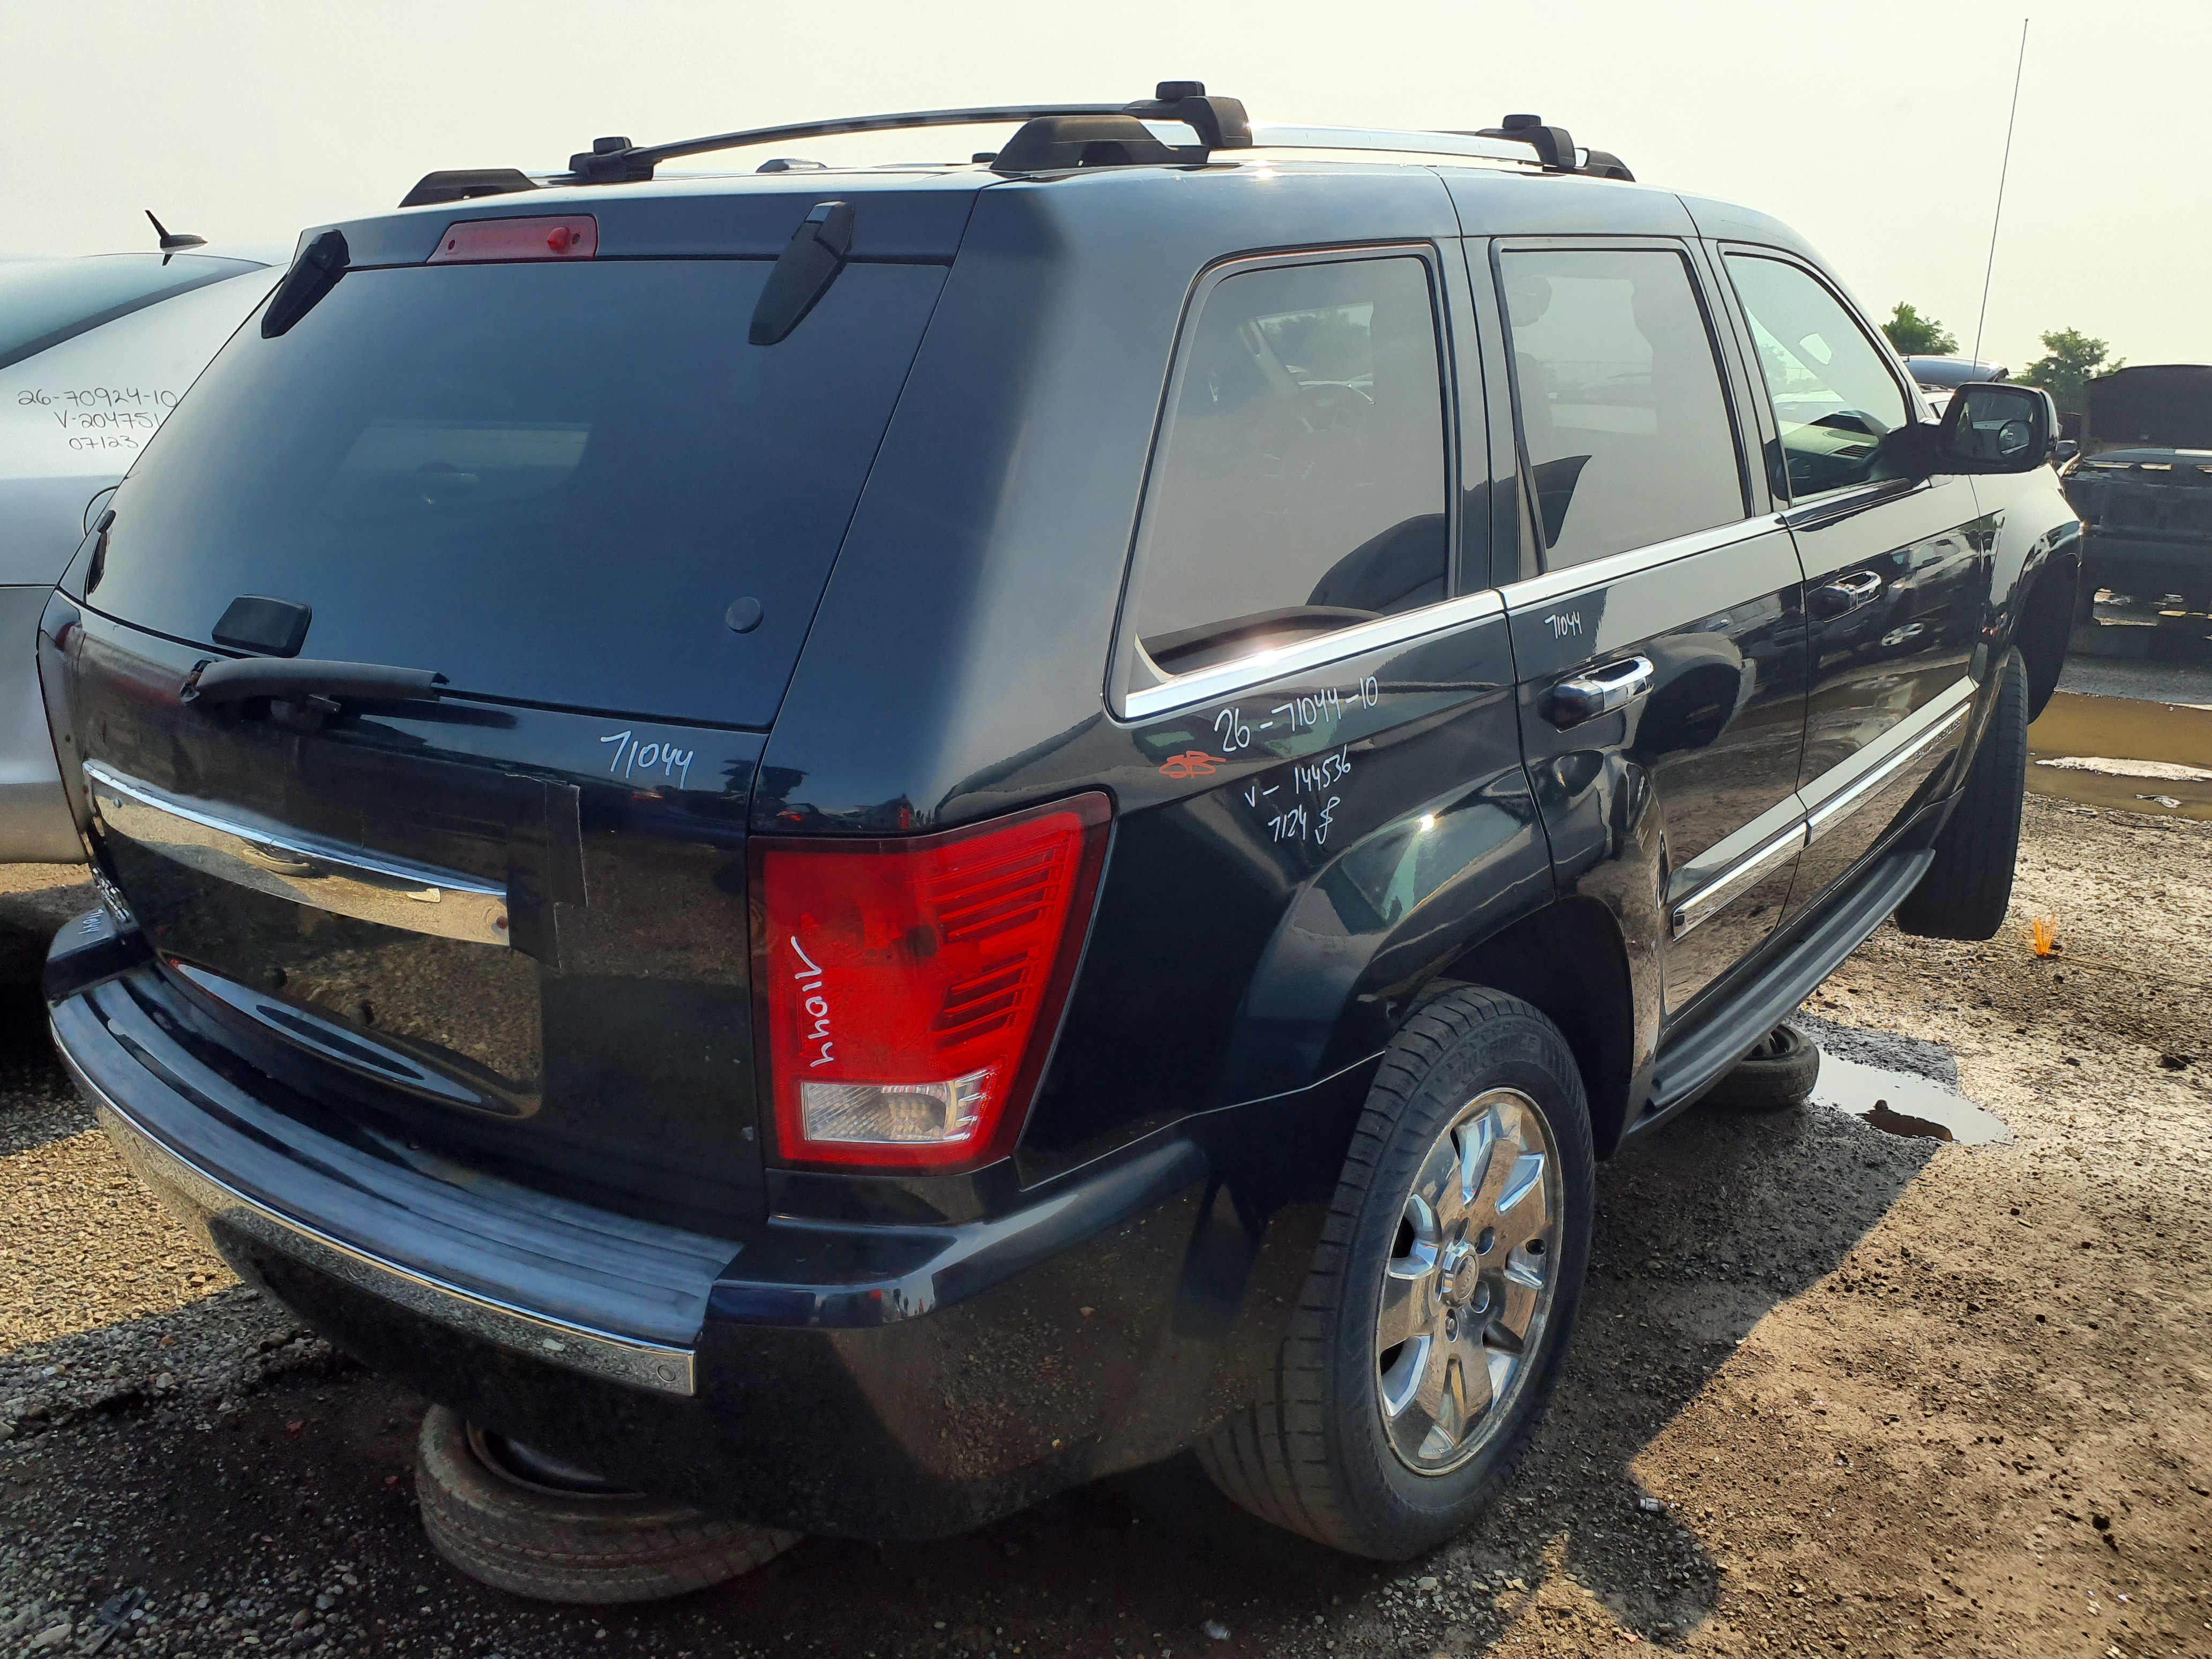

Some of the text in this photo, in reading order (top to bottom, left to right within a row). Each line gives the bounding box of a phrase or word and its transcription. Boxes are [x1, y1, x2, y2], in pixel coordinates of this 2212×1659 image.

[18, 387, 177, 408] 26-70924-10
[1544, 610, 1582, 639] 71044
[600, 730, 694, 790] 71044
[790, 936, 834, 1067] 71044
